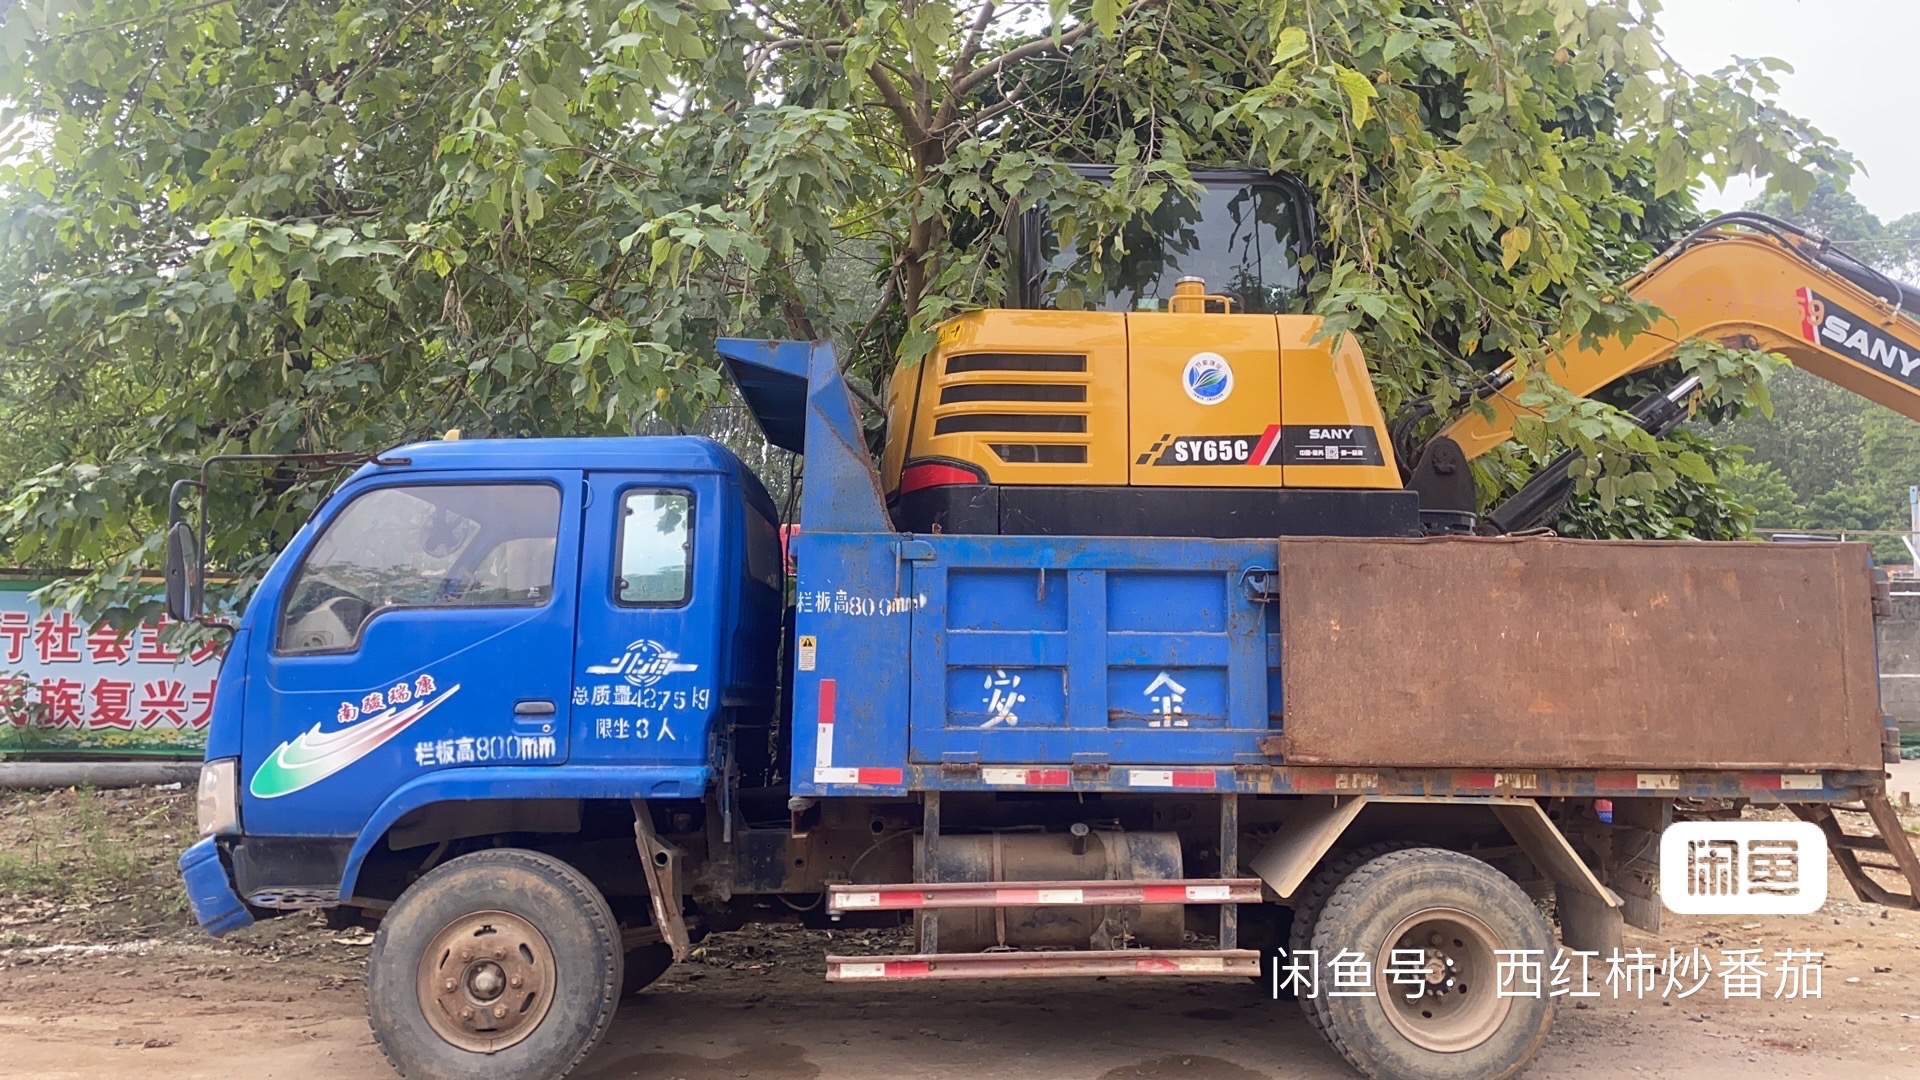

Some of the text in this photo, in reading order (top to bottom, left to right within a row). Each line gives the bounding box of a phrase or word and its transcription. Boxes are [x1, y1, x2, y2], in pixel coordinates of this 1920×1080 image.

[1821, 315, 1920, 377] SANY
[1309, 428, 1353, 440] SANY
[1174, 440, 1249, 462] SY65C
[338, 674, 436, 723] 南骏瑞康
[414, 735, 556, 766] 栏板高800mm
